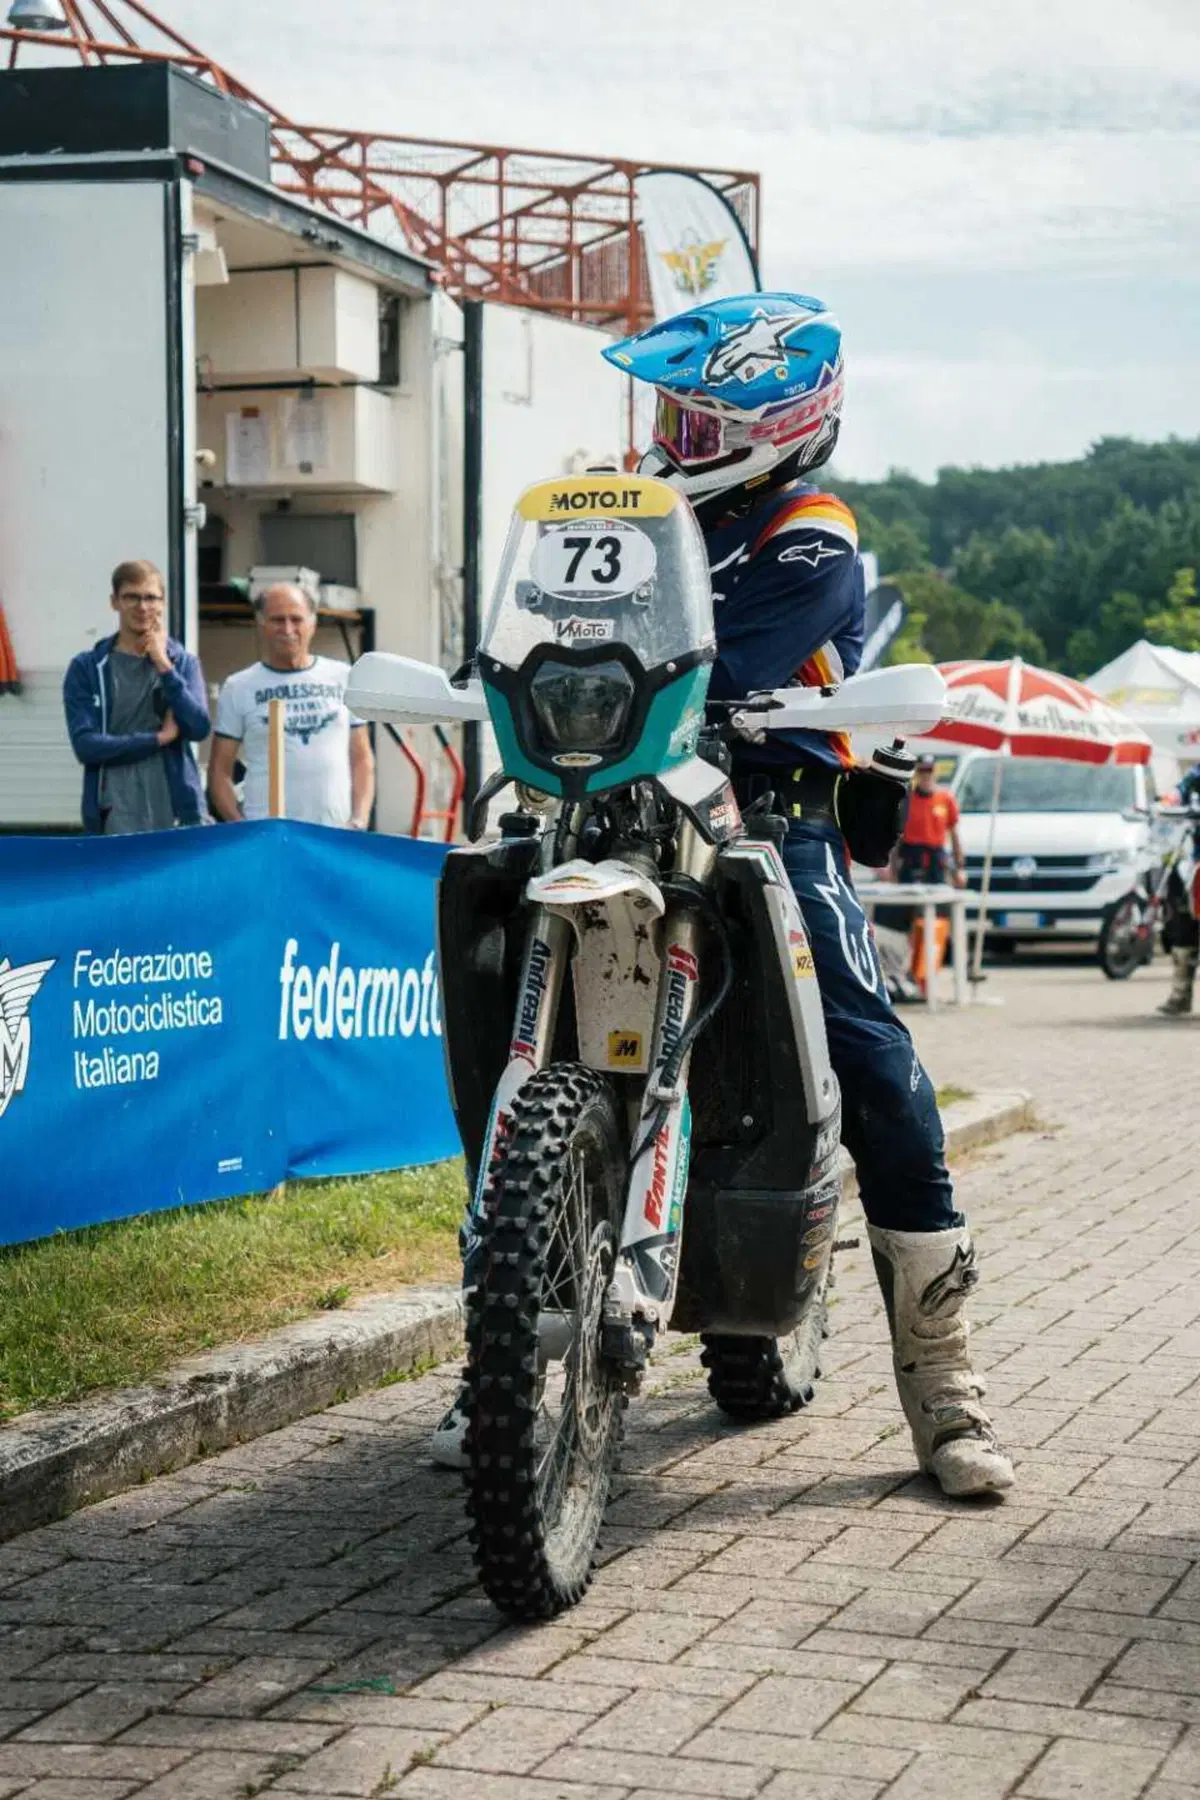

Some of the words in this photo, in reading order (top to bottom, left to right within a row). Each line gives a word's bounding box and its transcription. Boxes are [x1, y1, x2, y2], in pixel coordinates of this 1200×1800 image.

[549, 489, 642, 512] MOTO.IT
[563, 536, 622, 584] 73
[73, 944, 213, 988] Federazione
[73, 990, 223, 1039] Motociclistica
[518, 937, 552, 1046] Andreani
[646, 970, 688, 1072] ndreani
[74, 1047, 160, 1089] Italiana
[644, 1125, 670, 1231] FANTIC
